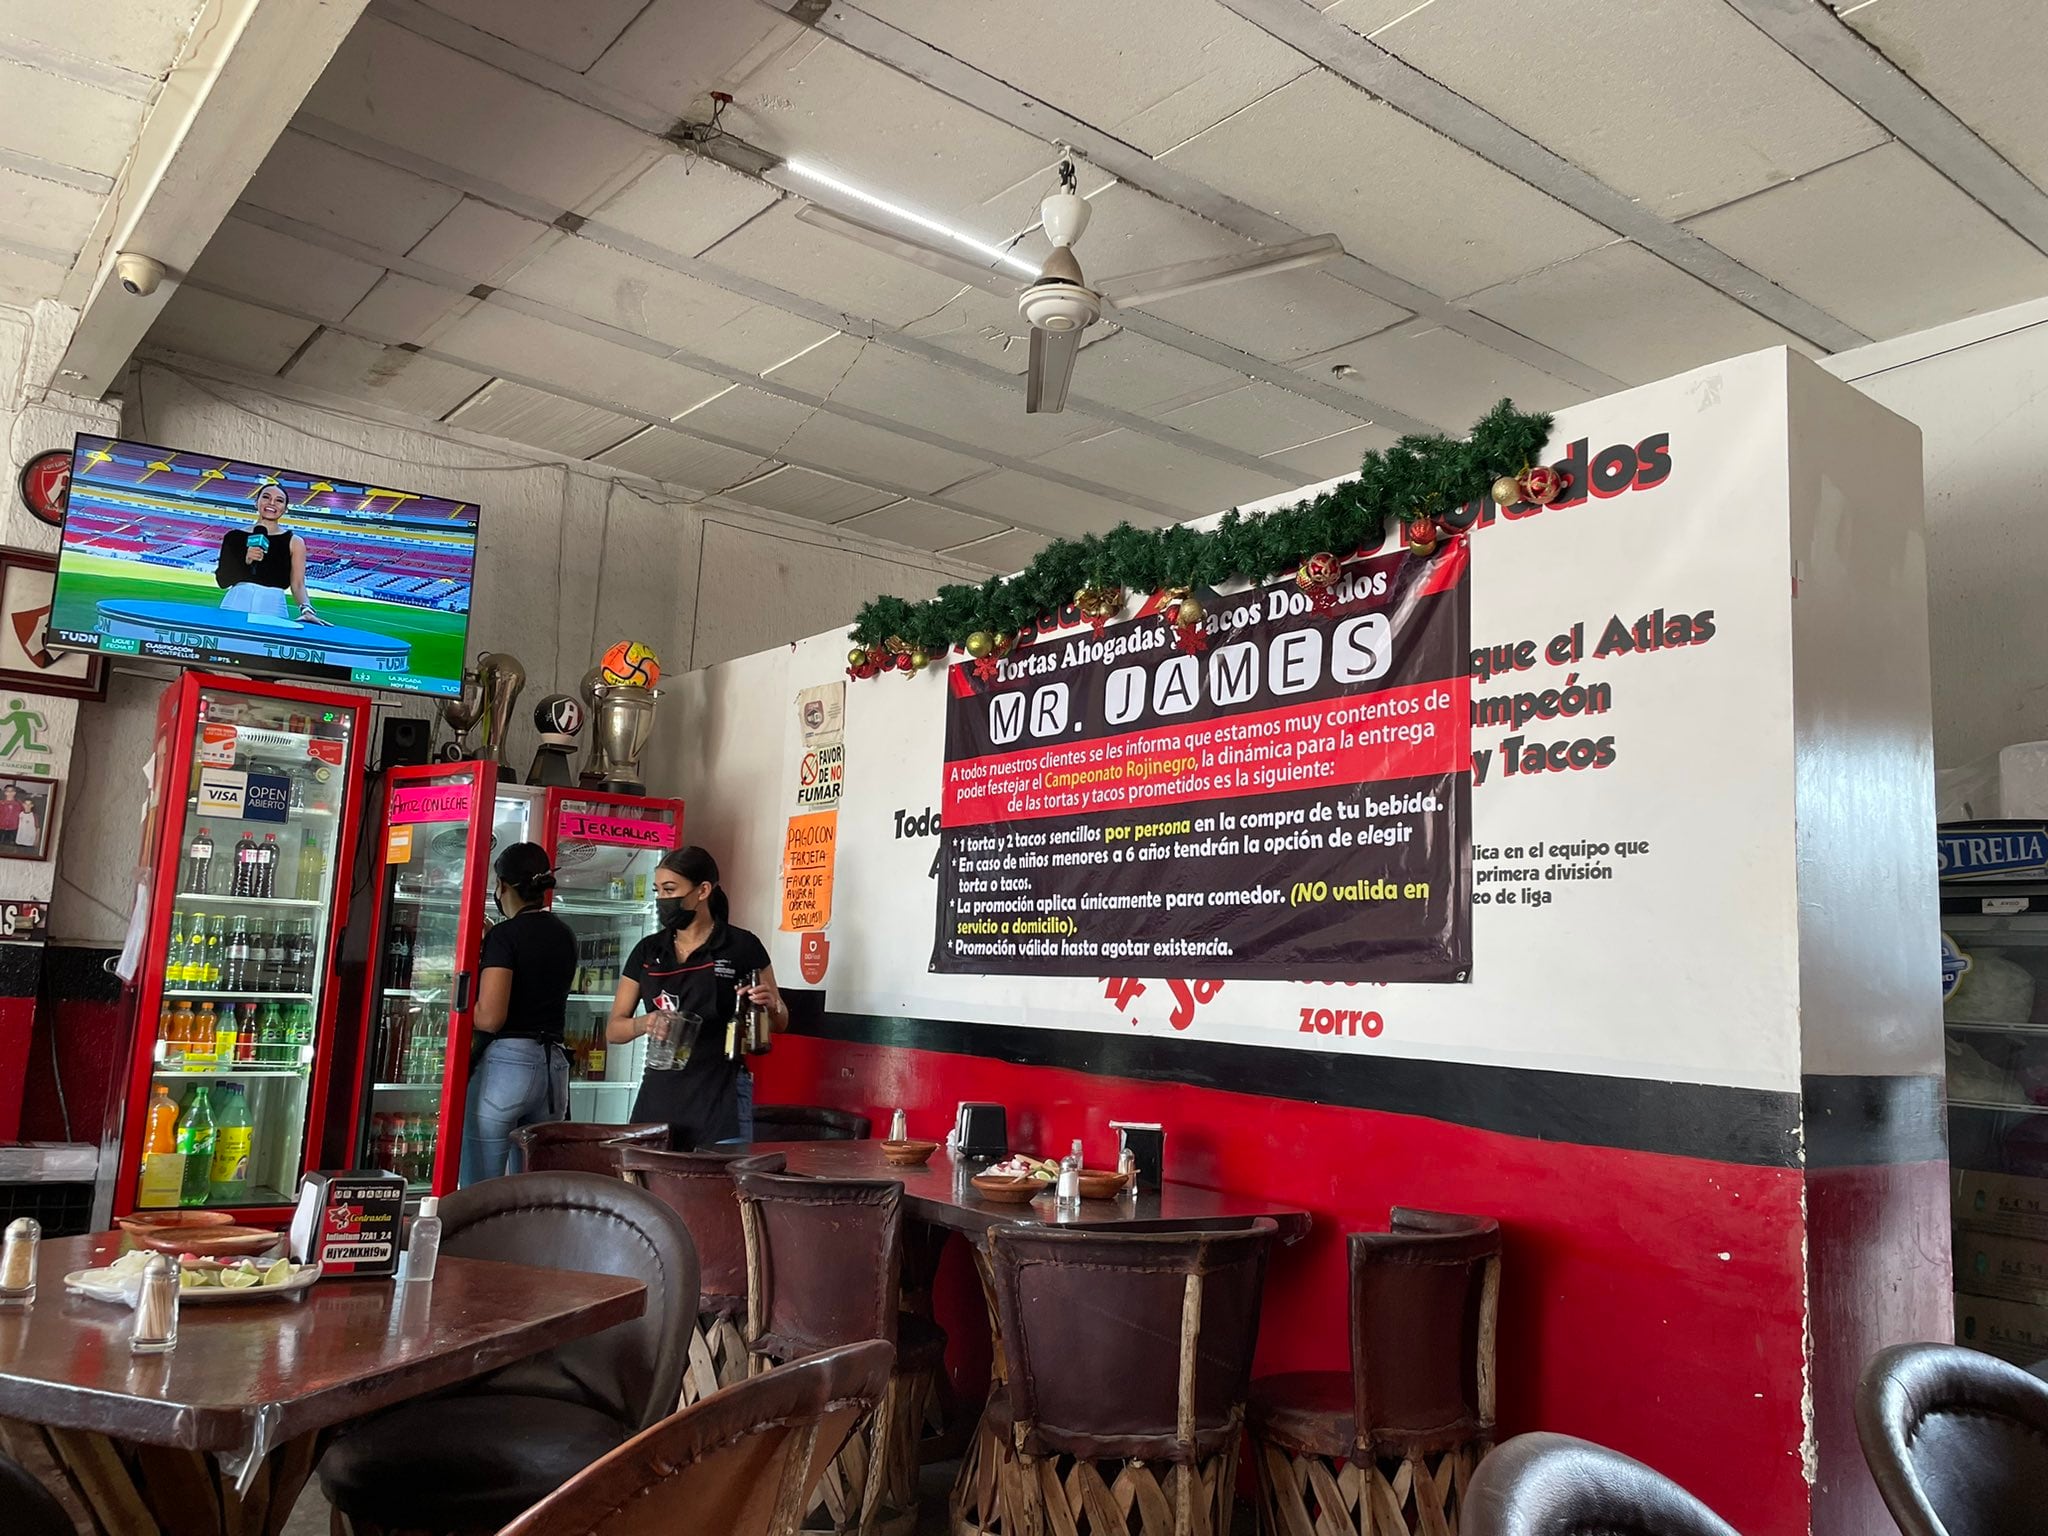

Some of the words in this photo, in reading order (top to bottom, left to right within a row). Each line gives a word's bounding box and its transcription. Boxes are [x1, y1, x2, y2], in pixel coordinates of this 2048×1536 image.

[59, 630, 99, 644] TUDN
[145, 642, 194, 653] CLASIFICACIÓN
[155, 629, 219, 651] TUDN
[1470, 640, 1538, 683] que
[1545, 622, 1584, 665] el
[1592, 608, 1717, 659] Atlas
[152, 650, 200, 660] MONTPELLIER
[263, 643, 326, 665] TUDN
[996, 650, 1057, 683] Tortas
[1061, 626, 1165, 669] Ahogadas
[991, 685, 1083, 744] MR.
[1105, 614, 1391, 724] JAMES
[951, 767, 960, 782] A
[961, 763, 987, 781] todos
[989, 756, 1038, 776] nuestros
[1040, 748, 1087, 769] clientes
[1090, 747, 1103, 761] se
[1106, 742, 1123, 760] les
[1126, 736, 1181, 757] informa
[1185, 731, 1211, 752] que
[1215, 720, 1281, 743] estamos
[1285, 713, 1322, 734] muy
[1327, 697, 1418, 728] contentos
[1424, 689, 1450, 711] de
[819, 746, 842, 766] FAVOR
[957, 784, 987, 803] poder
[988, 776, 1029, 798] festejar
[1032, 773, 1043, 789] el
[1045, 764, 1123, 791] Campeonato
[1126, 756, 1199, 780] Rojinegro,
[1202, 750, 1214, 768] la
[1217, 739, 1292, 766] dinámica
[1296, 731, 1336, 757] para
[1340, 729, 1353, 749] la
[1358, 722, 1435, 748] entrega
[1471, 748, 1493, 787] y
[1499, 734, 1617, 777] Tacos
[819, 767, 829, 784] DE
[831, 764, 842, 781] NO
[208, 789, 238, 802] VISA
[249, 786, 287, 801] OPEN
[798, 783, 841, 804] FUMAR
[1007, 796, 1022, 813] de
[1025, 794, 1041, 811] las
[1043, 790, 1079, 809] tortas
[1082, 792, 1090, 807] y
[1092, 786, 1125, 805] tacos
[1128, 775, 1211, 803] prometidos
[1213, 774, 1231, 790] es
[1235, 770, 1248, 787] la
[1253, 760, 1336, 789] siguiente:
[247, 799, 286, 811] ABIERTO
[421, 799, 439, 813] CON
[440, 797, 469, 812] LECHE
[571, 816, 660, 843] JERICALLAS
[967, 835, 996, 852] torta
[997, 838, 1005, 853] y
[1006, 834, 1014, 849] 2
[1015, 832, 1046, 848] tacos
[1049, 824, 1101, 845] sencillos
[1104, 825, 1131, 844] por
[1134, 818, 1191, 841] persona
[1194, 818, 1215, 833] en
[1219, 811, 1236, 831] la
[1240, 807, 1305, 831] compra
[1309, 802, 1333, 823] de
[1337, 801, 1360, 820] tu
[1365, 792, 1444, 818] bebida.
[790, 850, 827, 866] TARJETA
[958, 857, 974, 873] En
[976, 857, 1001, 872] caso
[1003, 854, 1017, 870] de
[1018, 851, 1049, 869] niños
[1052, 850, 1109, 867] menores
[1112, 851, 1123, 863] a
[1125, 846, 1135, 862] 6
[1138, 842, 1171, 861] años
[1173, 836, 1239, 858] tendrán
[1243, 834, 1260, 854] la
[1264, 829, 1323, 855] opción
[1328, 827, 1353, 848] de
[1357, 822, 1413, 847] elegir
[1504, 846, 1524, 859] en
[1528, 842, 1544, 858] el
[1549, 839, 1610, 860] equipo
[1614, 840, 1650, 858] que
[786, 875, 811, 889] FAVOR
[812, 874, 823, 887] DE
[1476, 866, 1540, 886] primera
[1545, 860, 1613, 881] división
[958, 878, 988, 893] torta
[990, 881, 998, 892] o
[1000, 876, 1032, 892] tacos.
[957, 899, 971, 914] La
[973, 895, 1034, 916] promoción
[1036, 893, 1077, 914] aplica
[1080, 891, 1162, 911] únicamente
[1165, 891, 1205, 910] para
[1208, 884, 1286, 907] comedor.
[1291, 882, 1328, 908] (NO
[1332, 879, 1398, 901] valida
[1403, 882, 1430, 900] en
[1495, 888, 1517, 904] de
[1521, 887, 1552, 908] liga
[957, 917, 998, 934] servicio
[1001, 921, 1009, 934] a
[1012, 916, 1078, 938] domicilio).
[955, 938, 1017, 957] Promoción
[1018, 938, 1058, 956] válida
[1061, 938, 1098, 957] hasta
[1101, 938, 1150, 960] agotar
[1153, 937, 1234, 957] existencia.
[1299, 1007, 1384, 1038] zorro
[357, 1189, 401, 1199] JAMES
[350, 1213, 392, 1223] Contraseña
